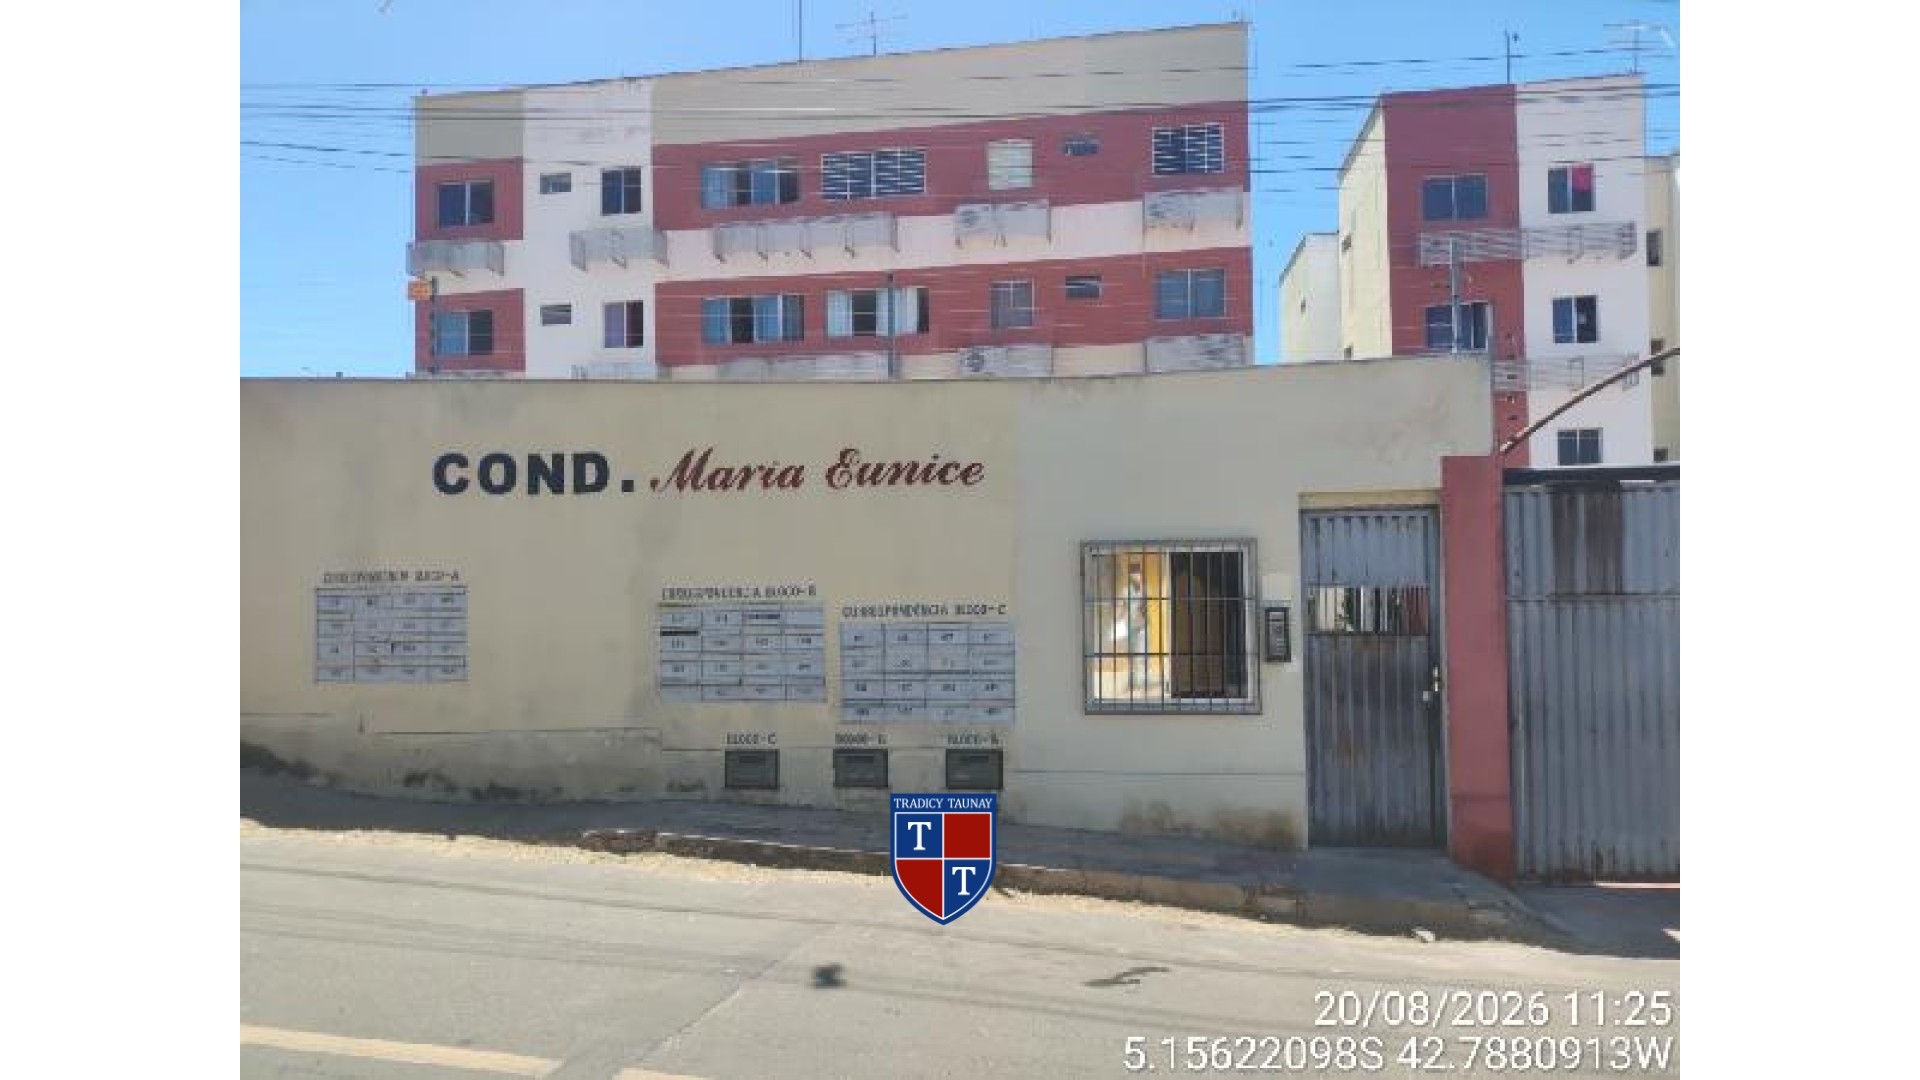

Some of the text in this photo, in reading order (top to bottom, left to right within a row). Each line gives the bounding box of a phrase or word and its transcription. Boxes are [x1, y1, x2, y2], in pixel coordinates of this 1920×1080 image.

[433, 447, 985, 495] COND. Maria Eunice
